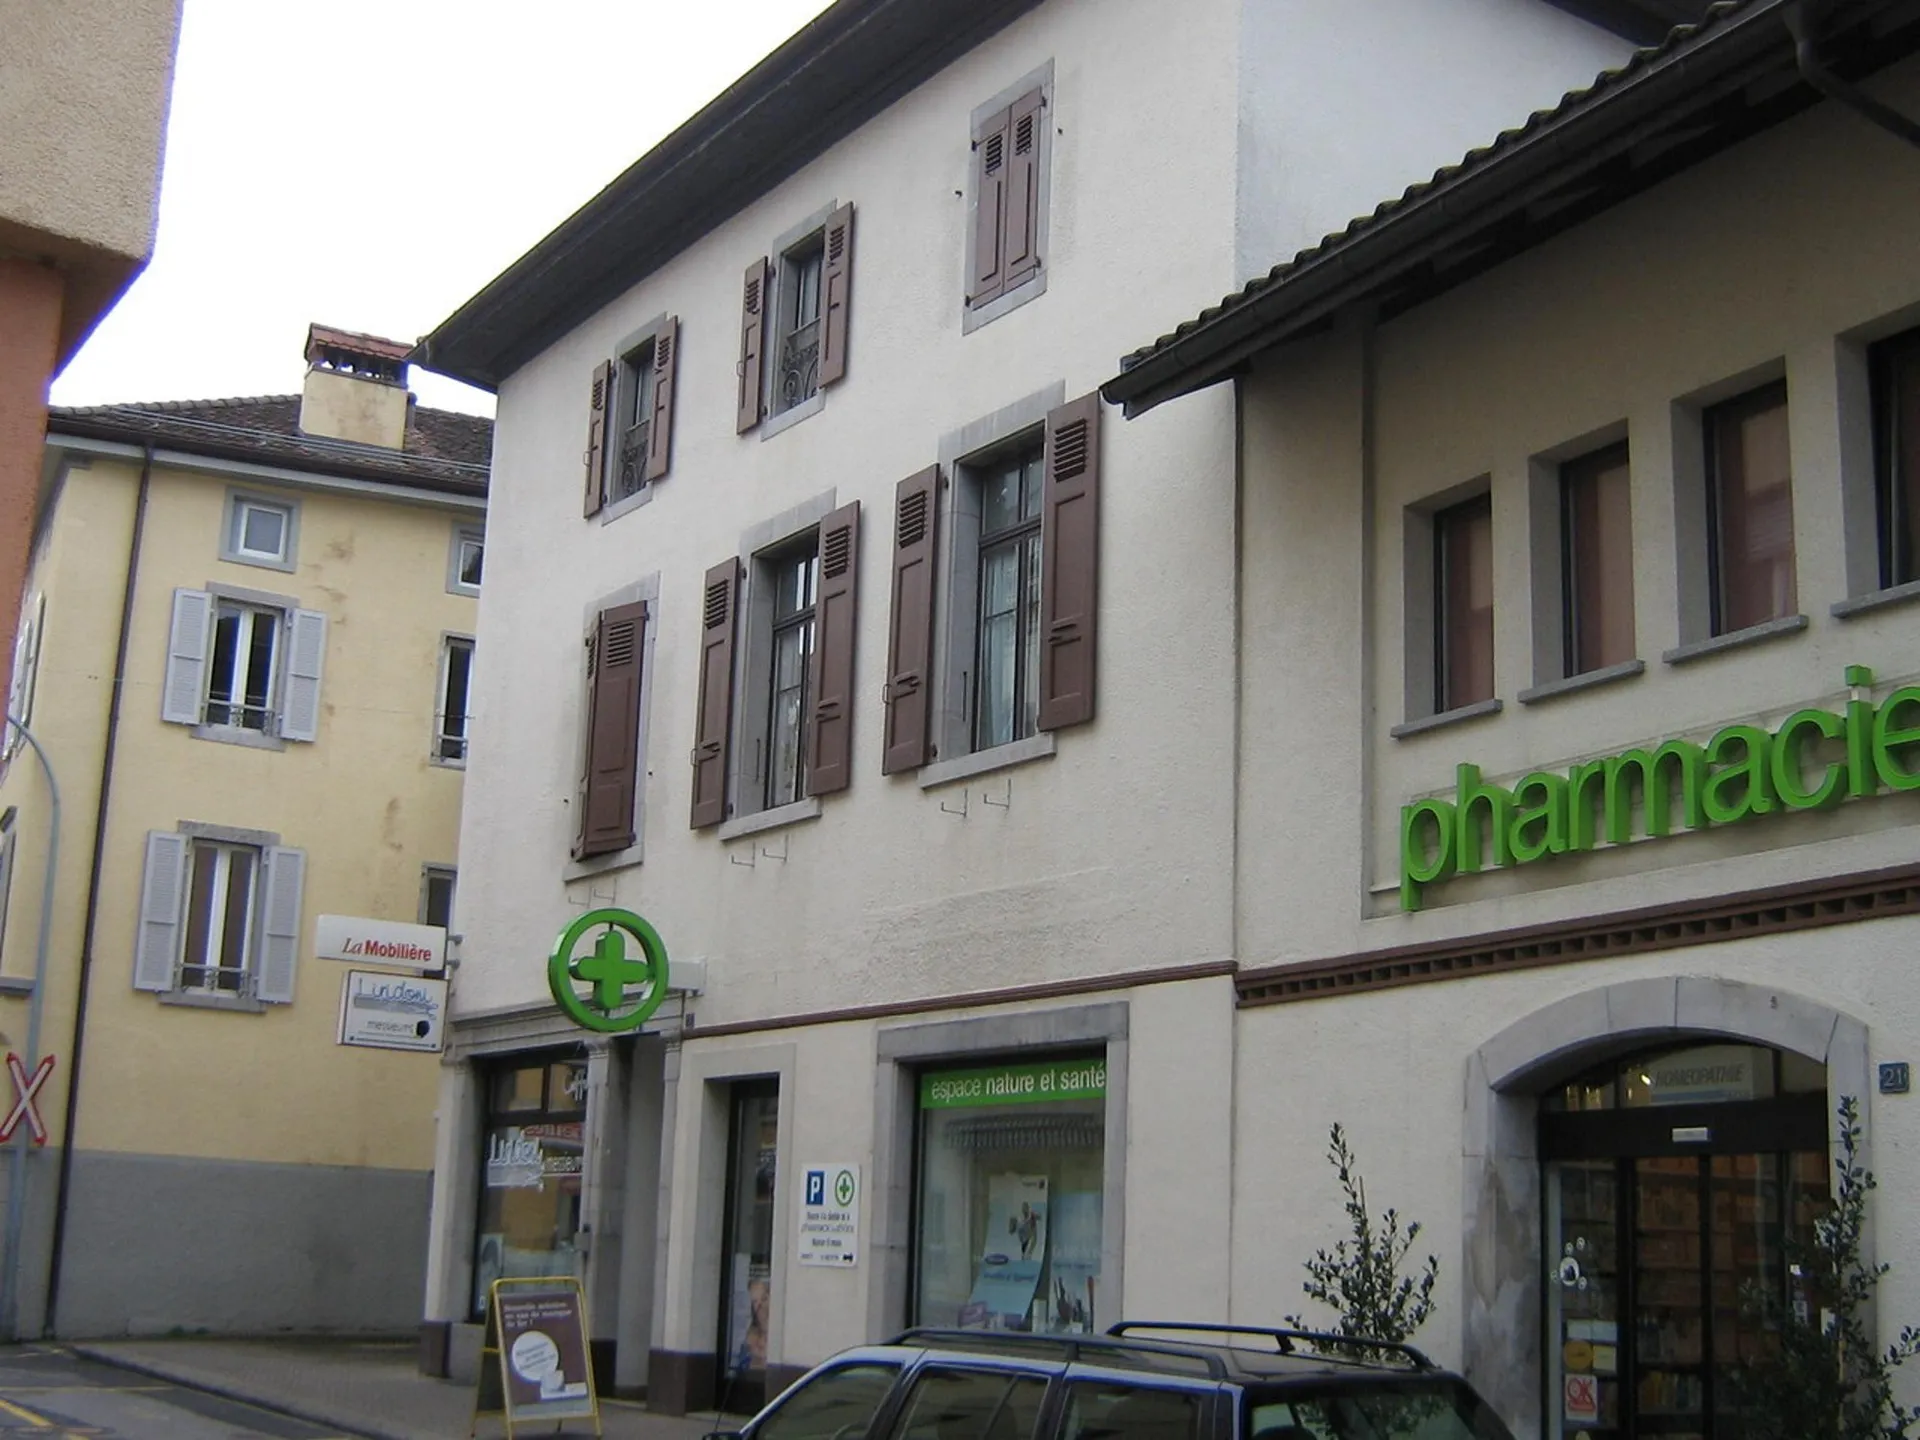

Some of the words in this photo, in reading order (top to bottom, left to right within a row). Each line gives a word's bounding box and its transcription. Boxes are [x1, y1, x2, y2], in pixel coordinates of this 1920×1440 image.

[1400, 664, 1920, 912] pharmacie
[341, 937, 363, 954] La
[364, 939, 432, 962] Mobilière
[931, 1077, 982, 1103] espace
[985, 1071, 1034, 1095] nature
[1040, 1069, 1056, 1091] et
[1060, 1061, 1106, 1090] santé
[1883, 1067, 1903, 1087] 21
[810, 1175, 821, 1202] P
